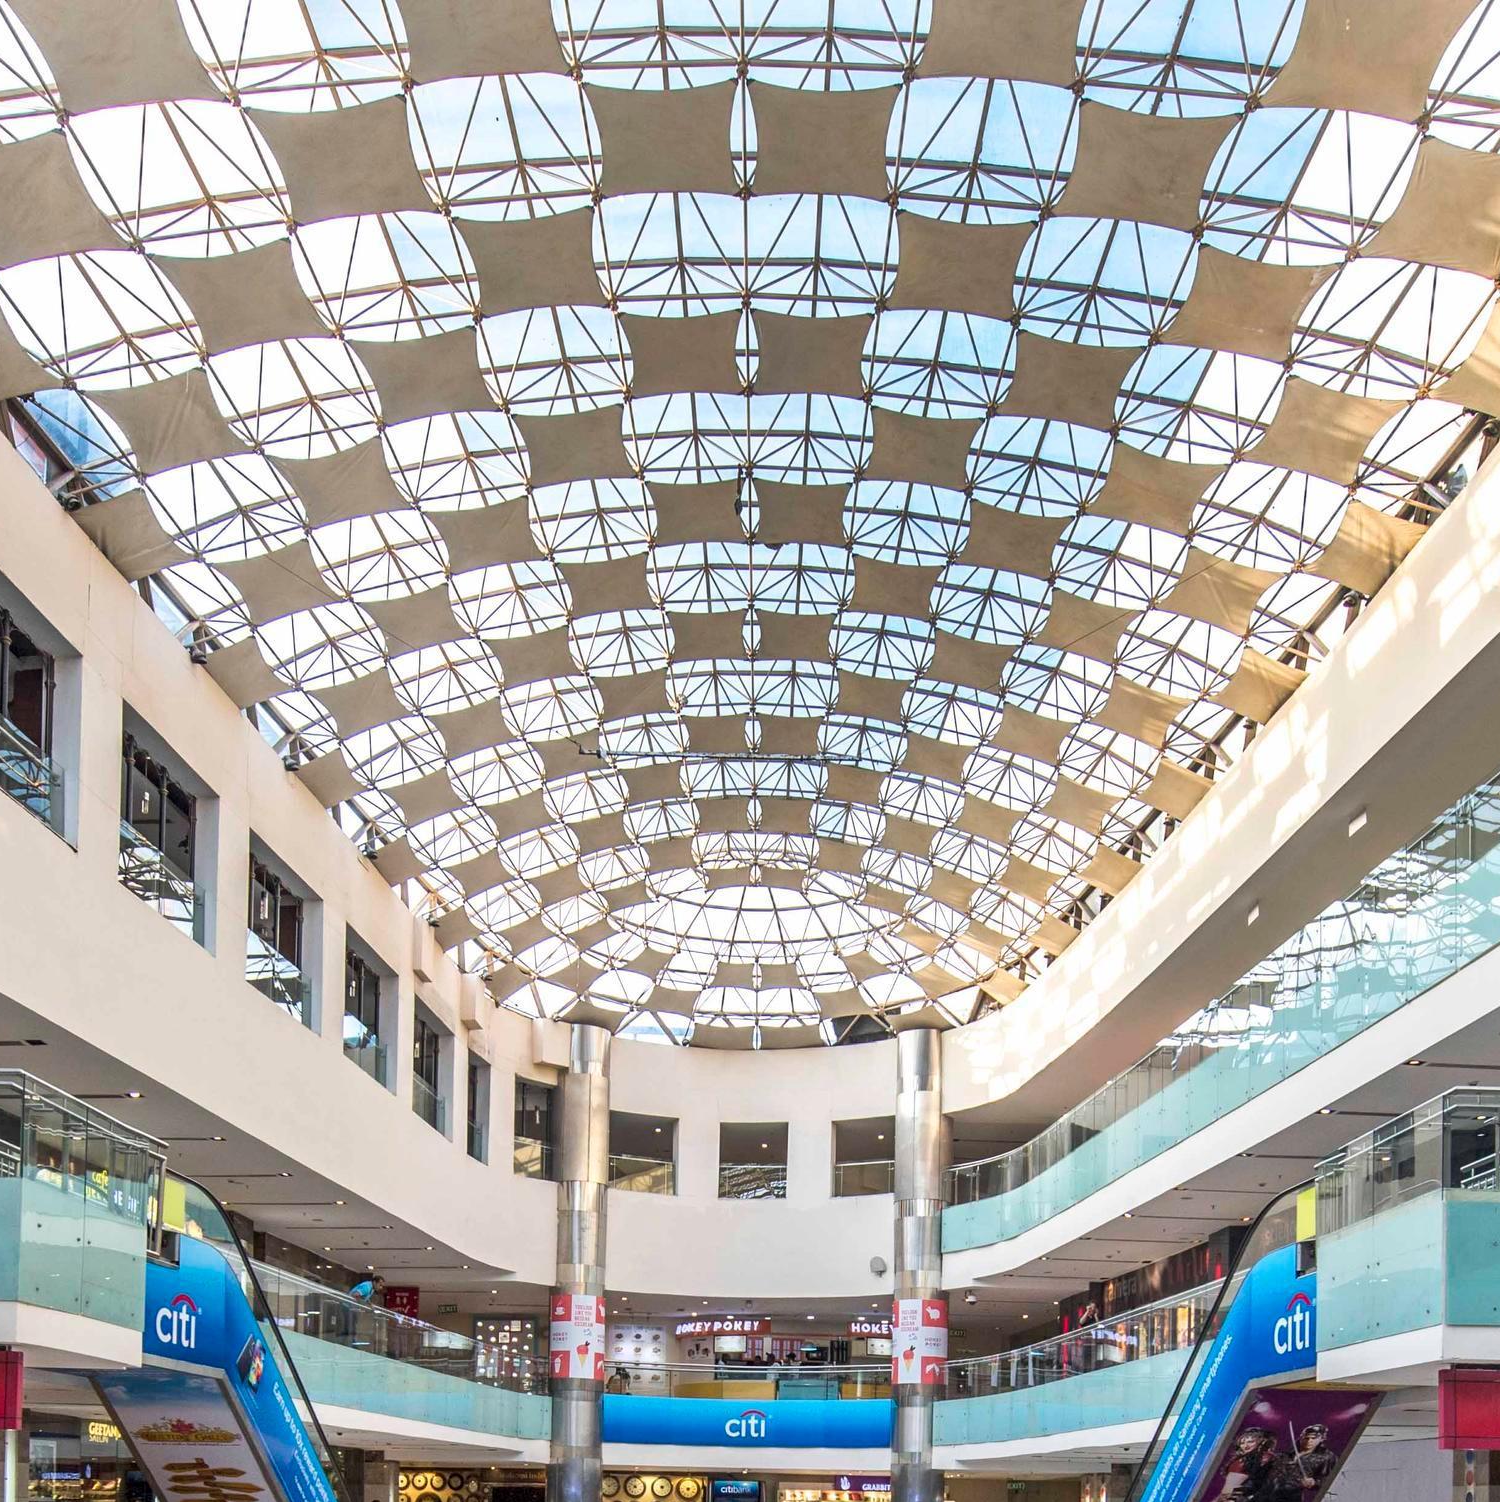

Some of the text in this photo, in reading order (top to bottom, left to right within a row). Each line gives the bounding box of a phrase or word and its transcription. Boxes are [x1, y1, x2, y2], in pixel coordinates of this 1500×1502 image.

[155, 1301, 196, 1349] citi
[713, 1321, 760, 1332] POKEY
[1273, 1300, 1311, 1355] citi
[725, 1411, 766, 1438] citi
[1178, 1396, 1200, 1446] Samsung
